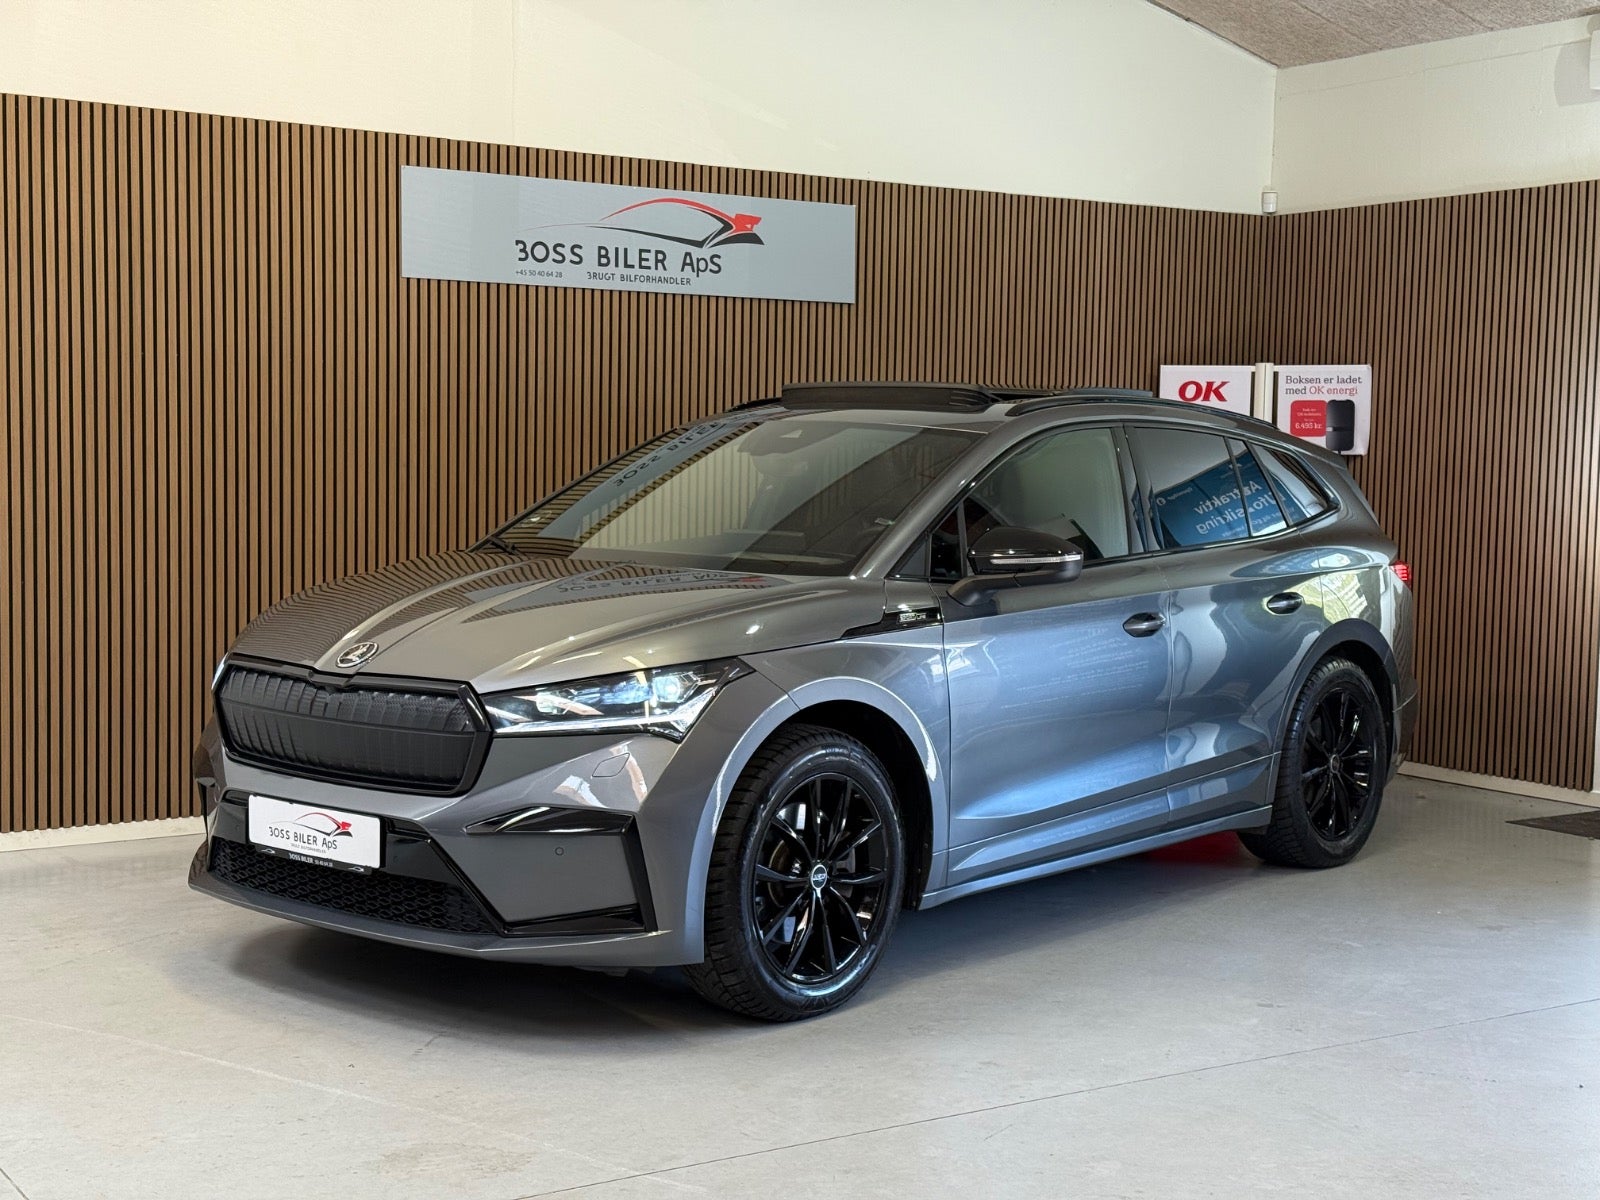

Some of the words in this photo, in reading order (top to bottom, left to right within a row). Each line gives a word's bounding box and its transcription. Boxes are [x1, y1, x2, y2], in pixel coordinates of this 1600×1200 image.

[597, 245, 668, 271] BILER
[680, 251, 722, 278] ApS
[546, 270, 553, 278] 64
[620, 273, 691, 286] BILFORHANDLER
[1285, 375, 1321, 384] Boksen
[1336, 375, 1363, 384] ladet
[1178, 380, 1230, 402] OK
[1285, 386, 1307, 395] med
[1309, 385, 1325, 394] OK
[1326, 386, 1358, 397] energi
[293, 831, 318, 847] BILER
[321, 837, 338, 851] ApS
